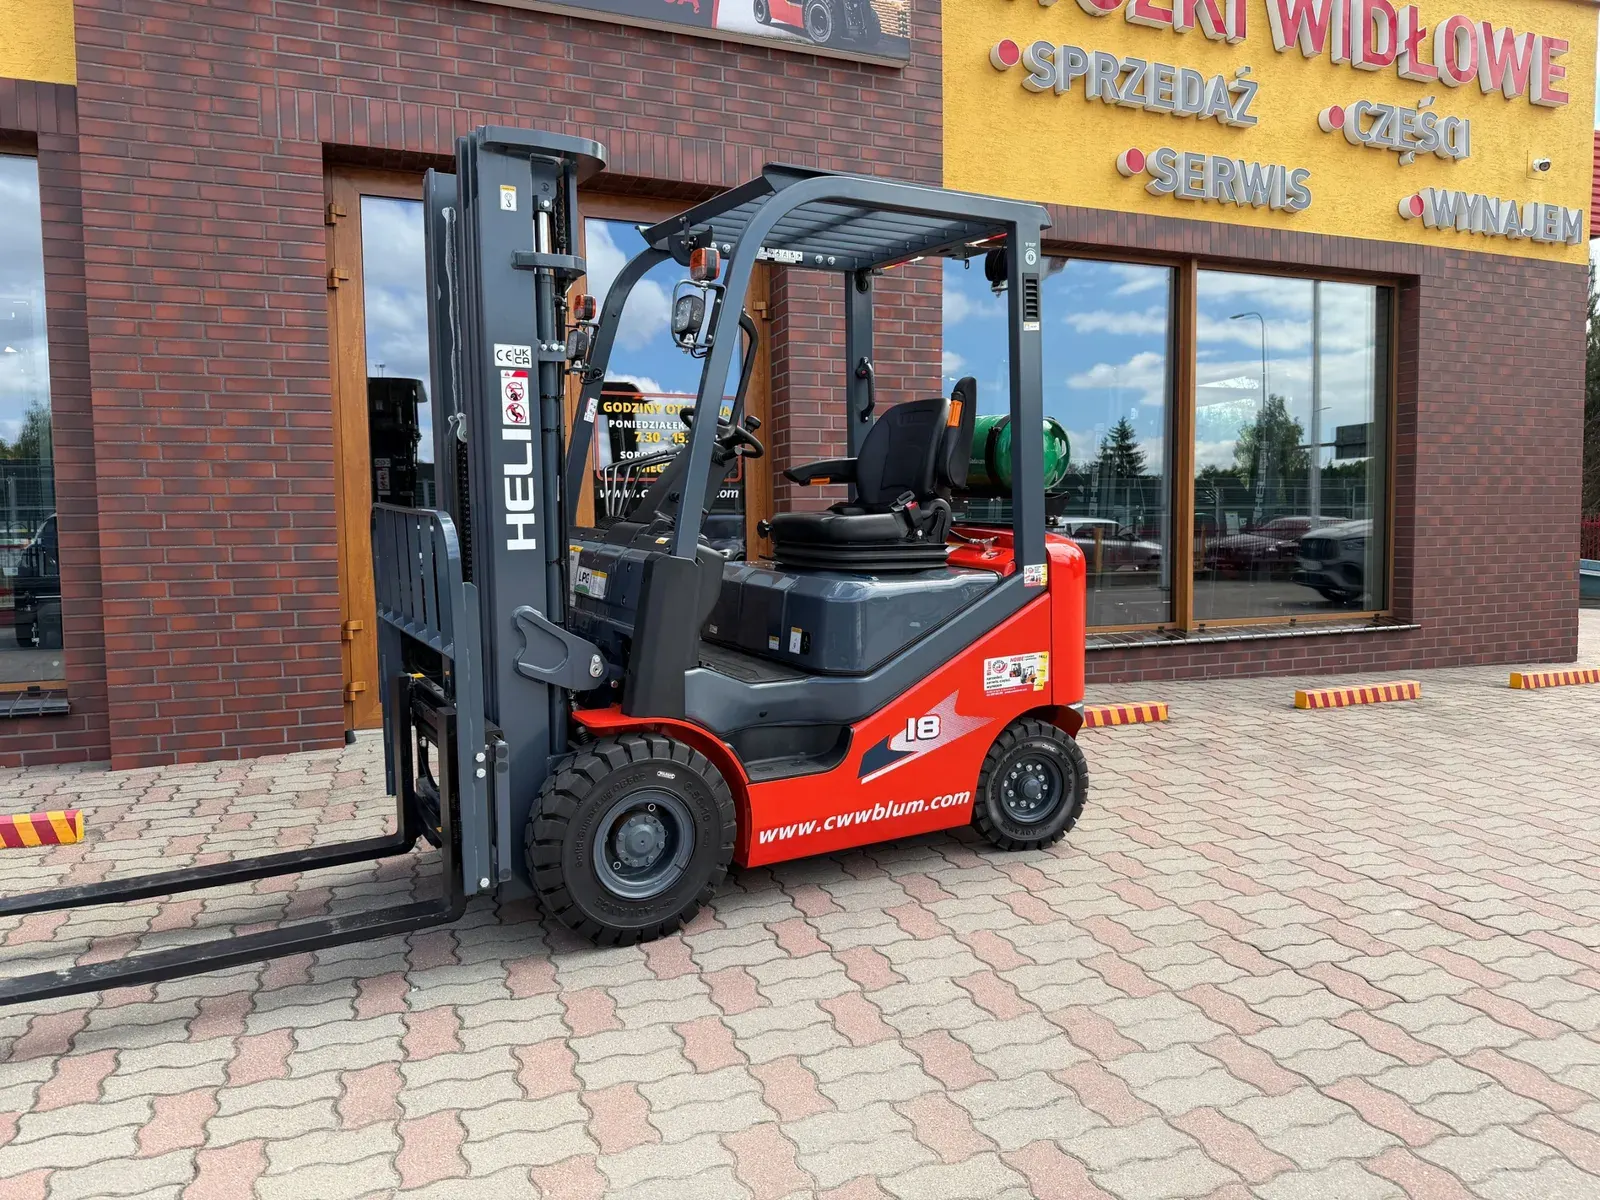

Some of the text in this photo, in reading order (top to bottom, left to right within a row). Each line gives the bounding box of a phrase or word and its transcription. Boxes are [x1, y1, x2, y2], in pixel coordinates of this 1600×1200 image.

[1265, 0, 1569, 107] WIDŁOWE
[1022, 40, 1258, 127] SPRZEDAŻ
[1344, 96, 1471, 165] CZĘŚCI
[1145, 147, 1312, 213] SERWIS
[1420, 187, 1583, 245] WYNAJEM
[496, 348, 529, 362] CE UK
[514, 356, 530, 365] CA
[603, 401, 662, 415] GODZINY
[608, 419, 685, 431] PONIEDZIAŁEK
[502, 428, 536, 550] HELI
[905, 713, 942, 742] 18
[758, 790, 971, 844] www.cwwblum.com
